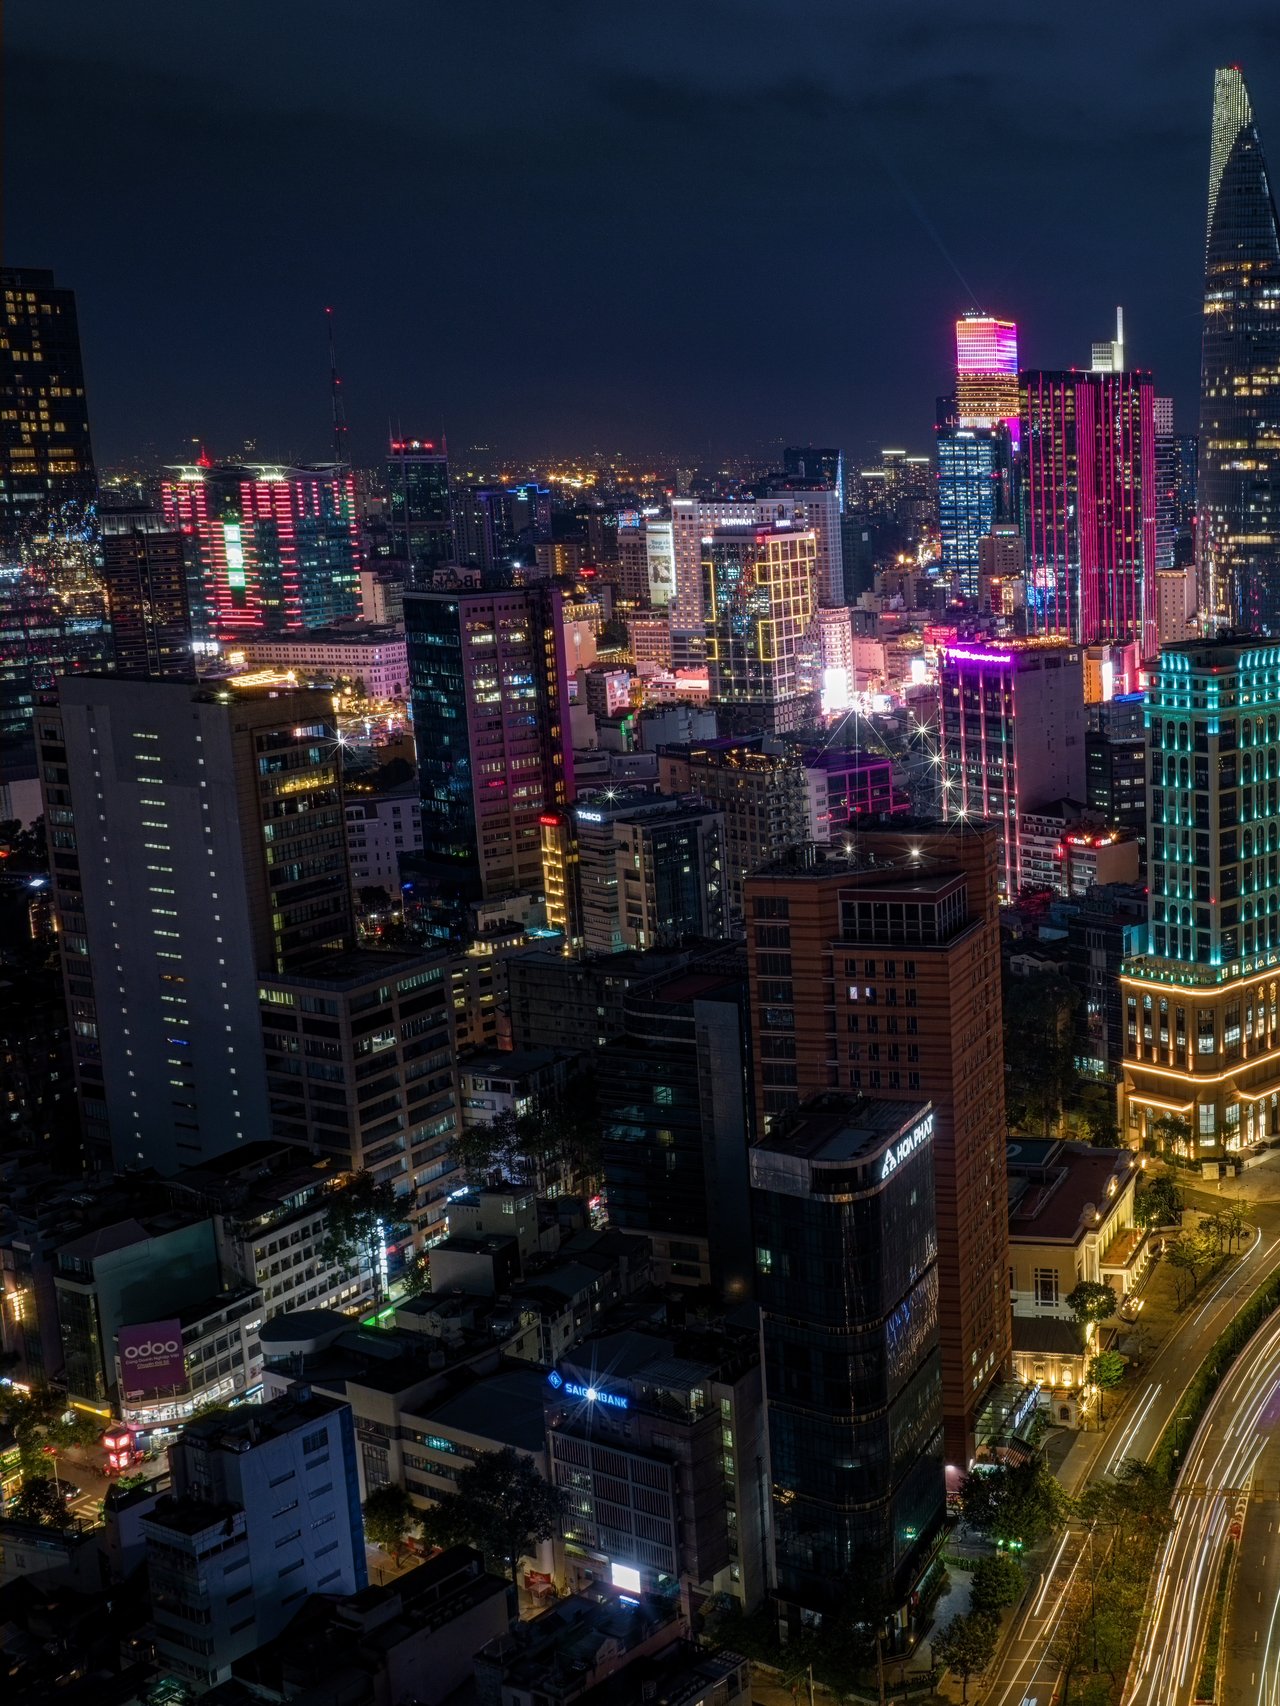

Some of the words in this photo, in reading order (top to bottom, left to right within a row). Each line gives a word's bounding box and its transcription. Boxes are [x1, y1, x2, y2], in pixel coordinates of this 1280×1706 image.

[577, 810, 602, 822] TASCO
[124, 1341, 178, 1358] odoo
[565, 1383, 628, 1409] SAIGNBANK
